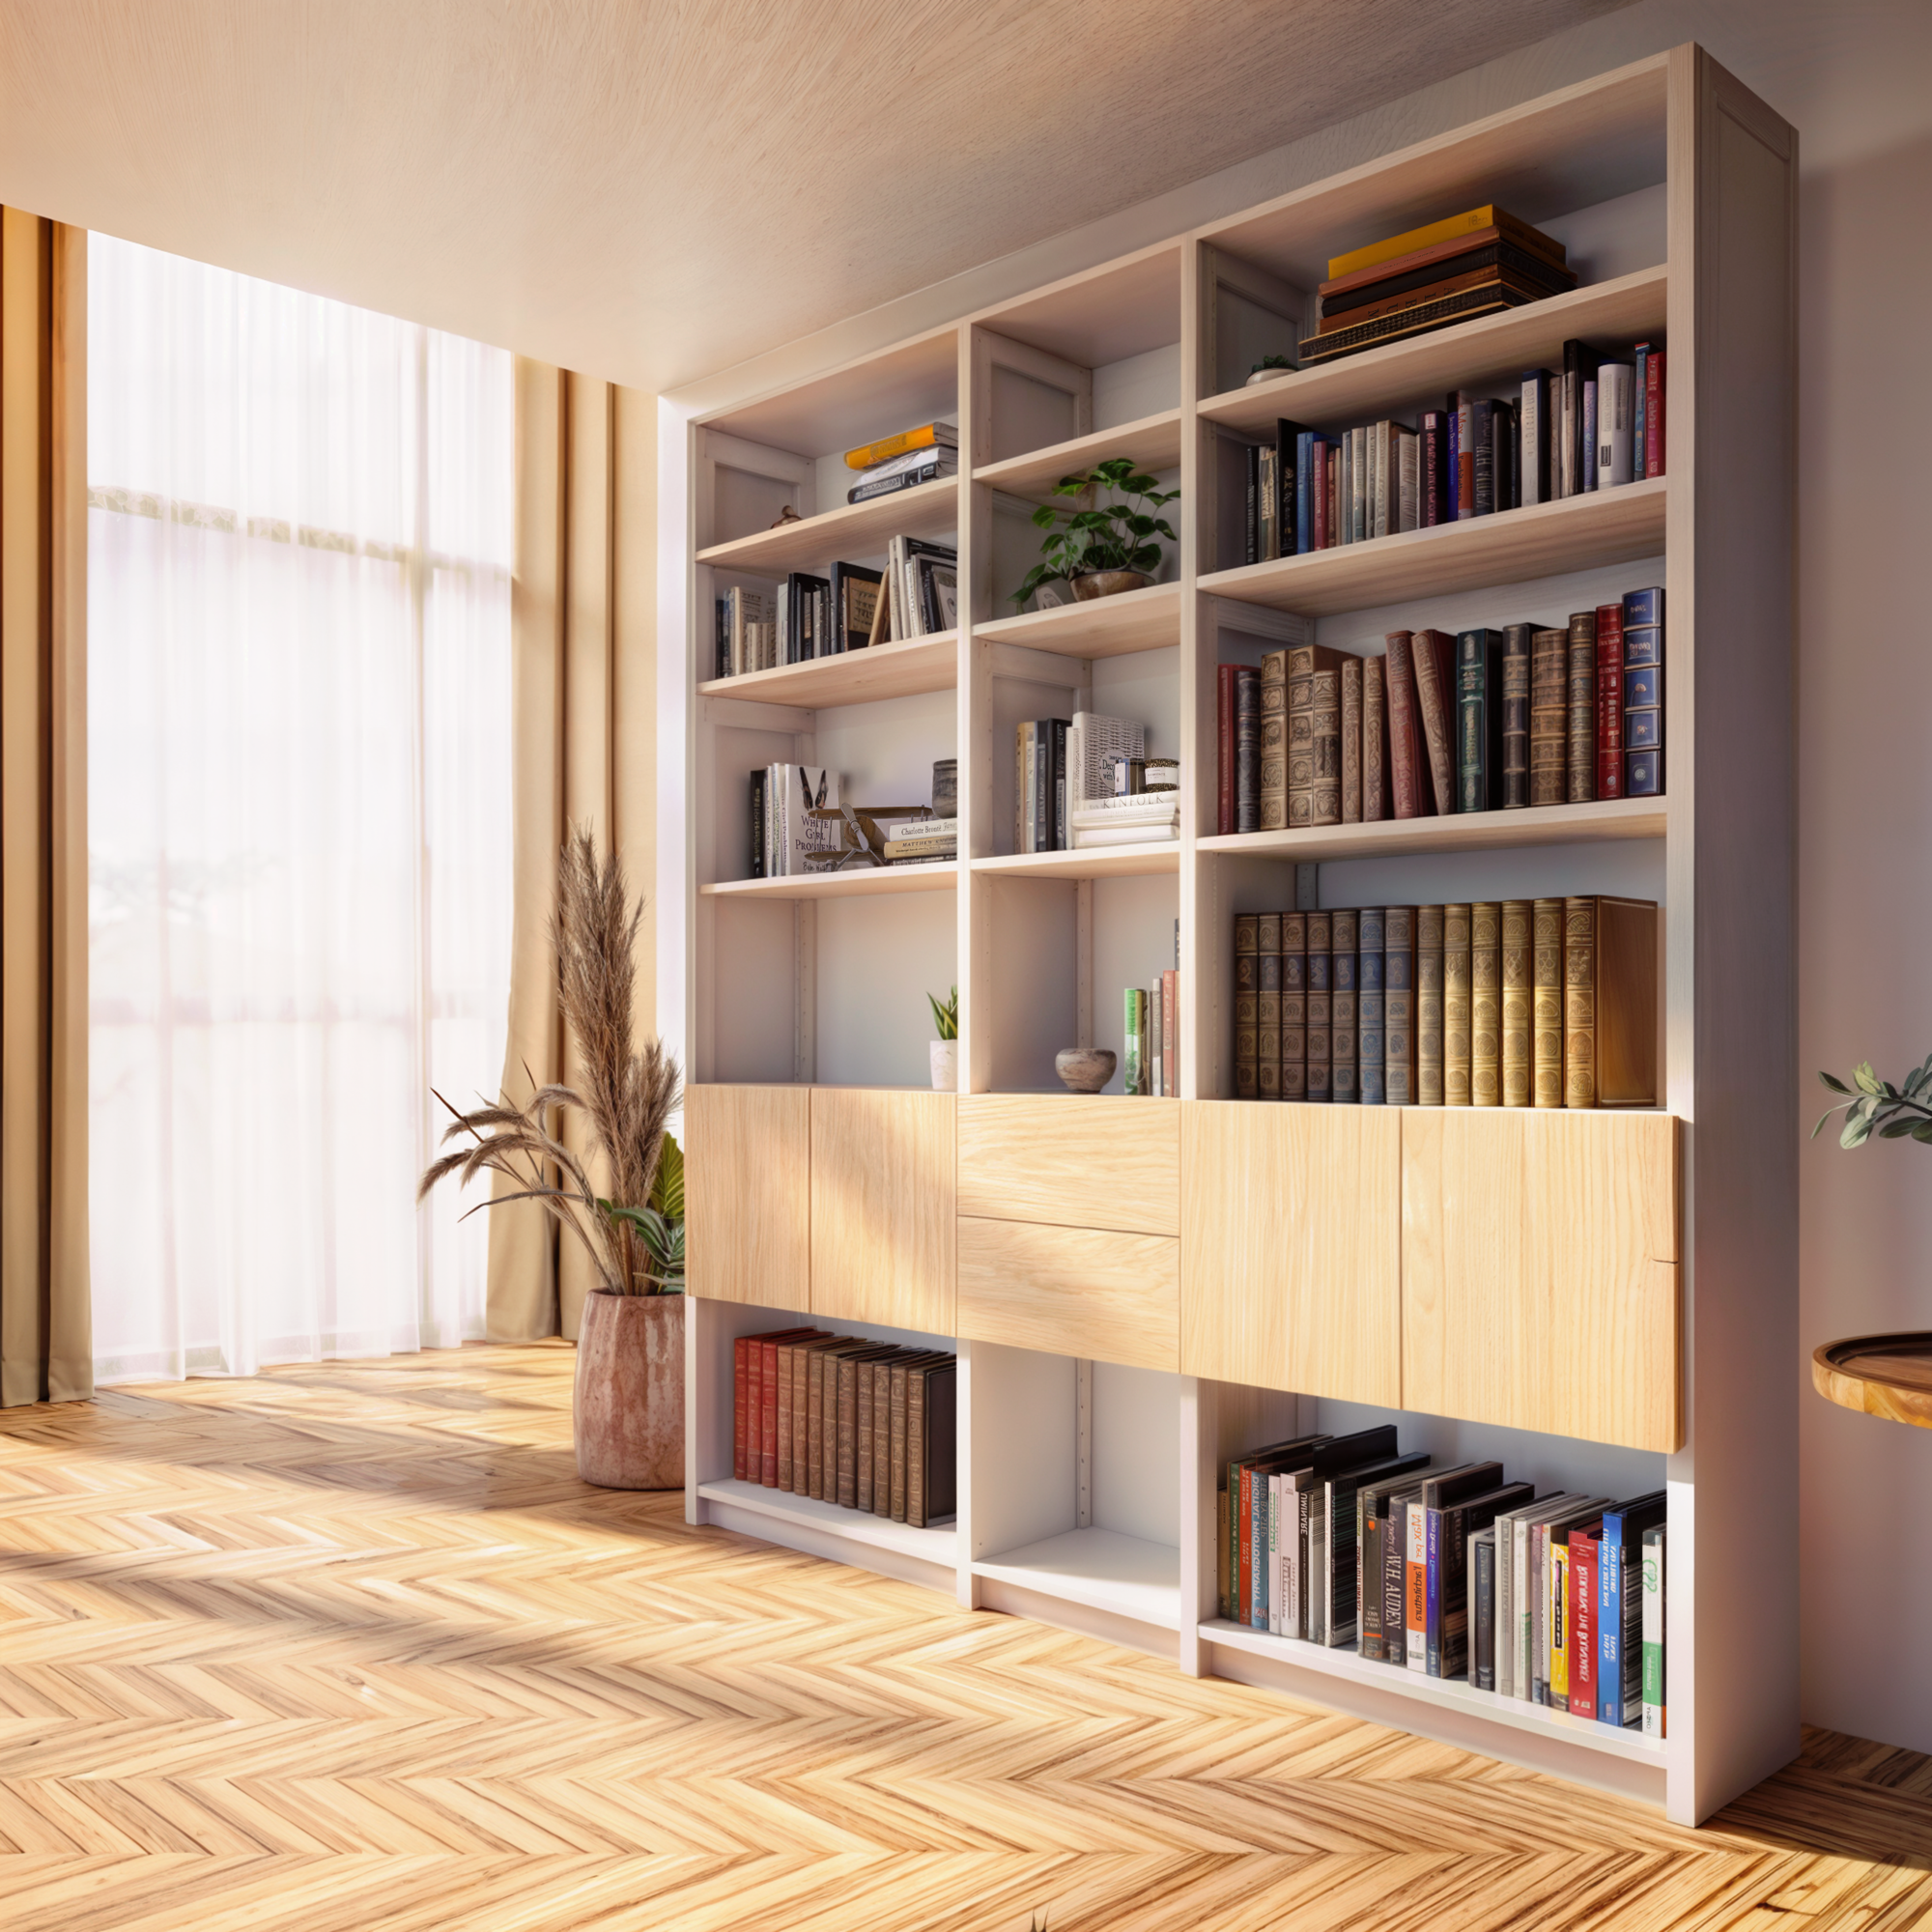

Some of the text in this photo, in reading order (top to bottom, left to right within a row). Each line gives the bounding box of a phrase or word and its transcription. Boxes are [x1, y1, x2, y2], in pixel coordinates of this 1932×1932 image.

[1103, 793, 1164, 810] KINFOLK
[801, 815, 829, 829] WHIE
[1385, 1554, 1401, 1579] W.H.
[1385, 1582, 1402, 1630] AUDEN
